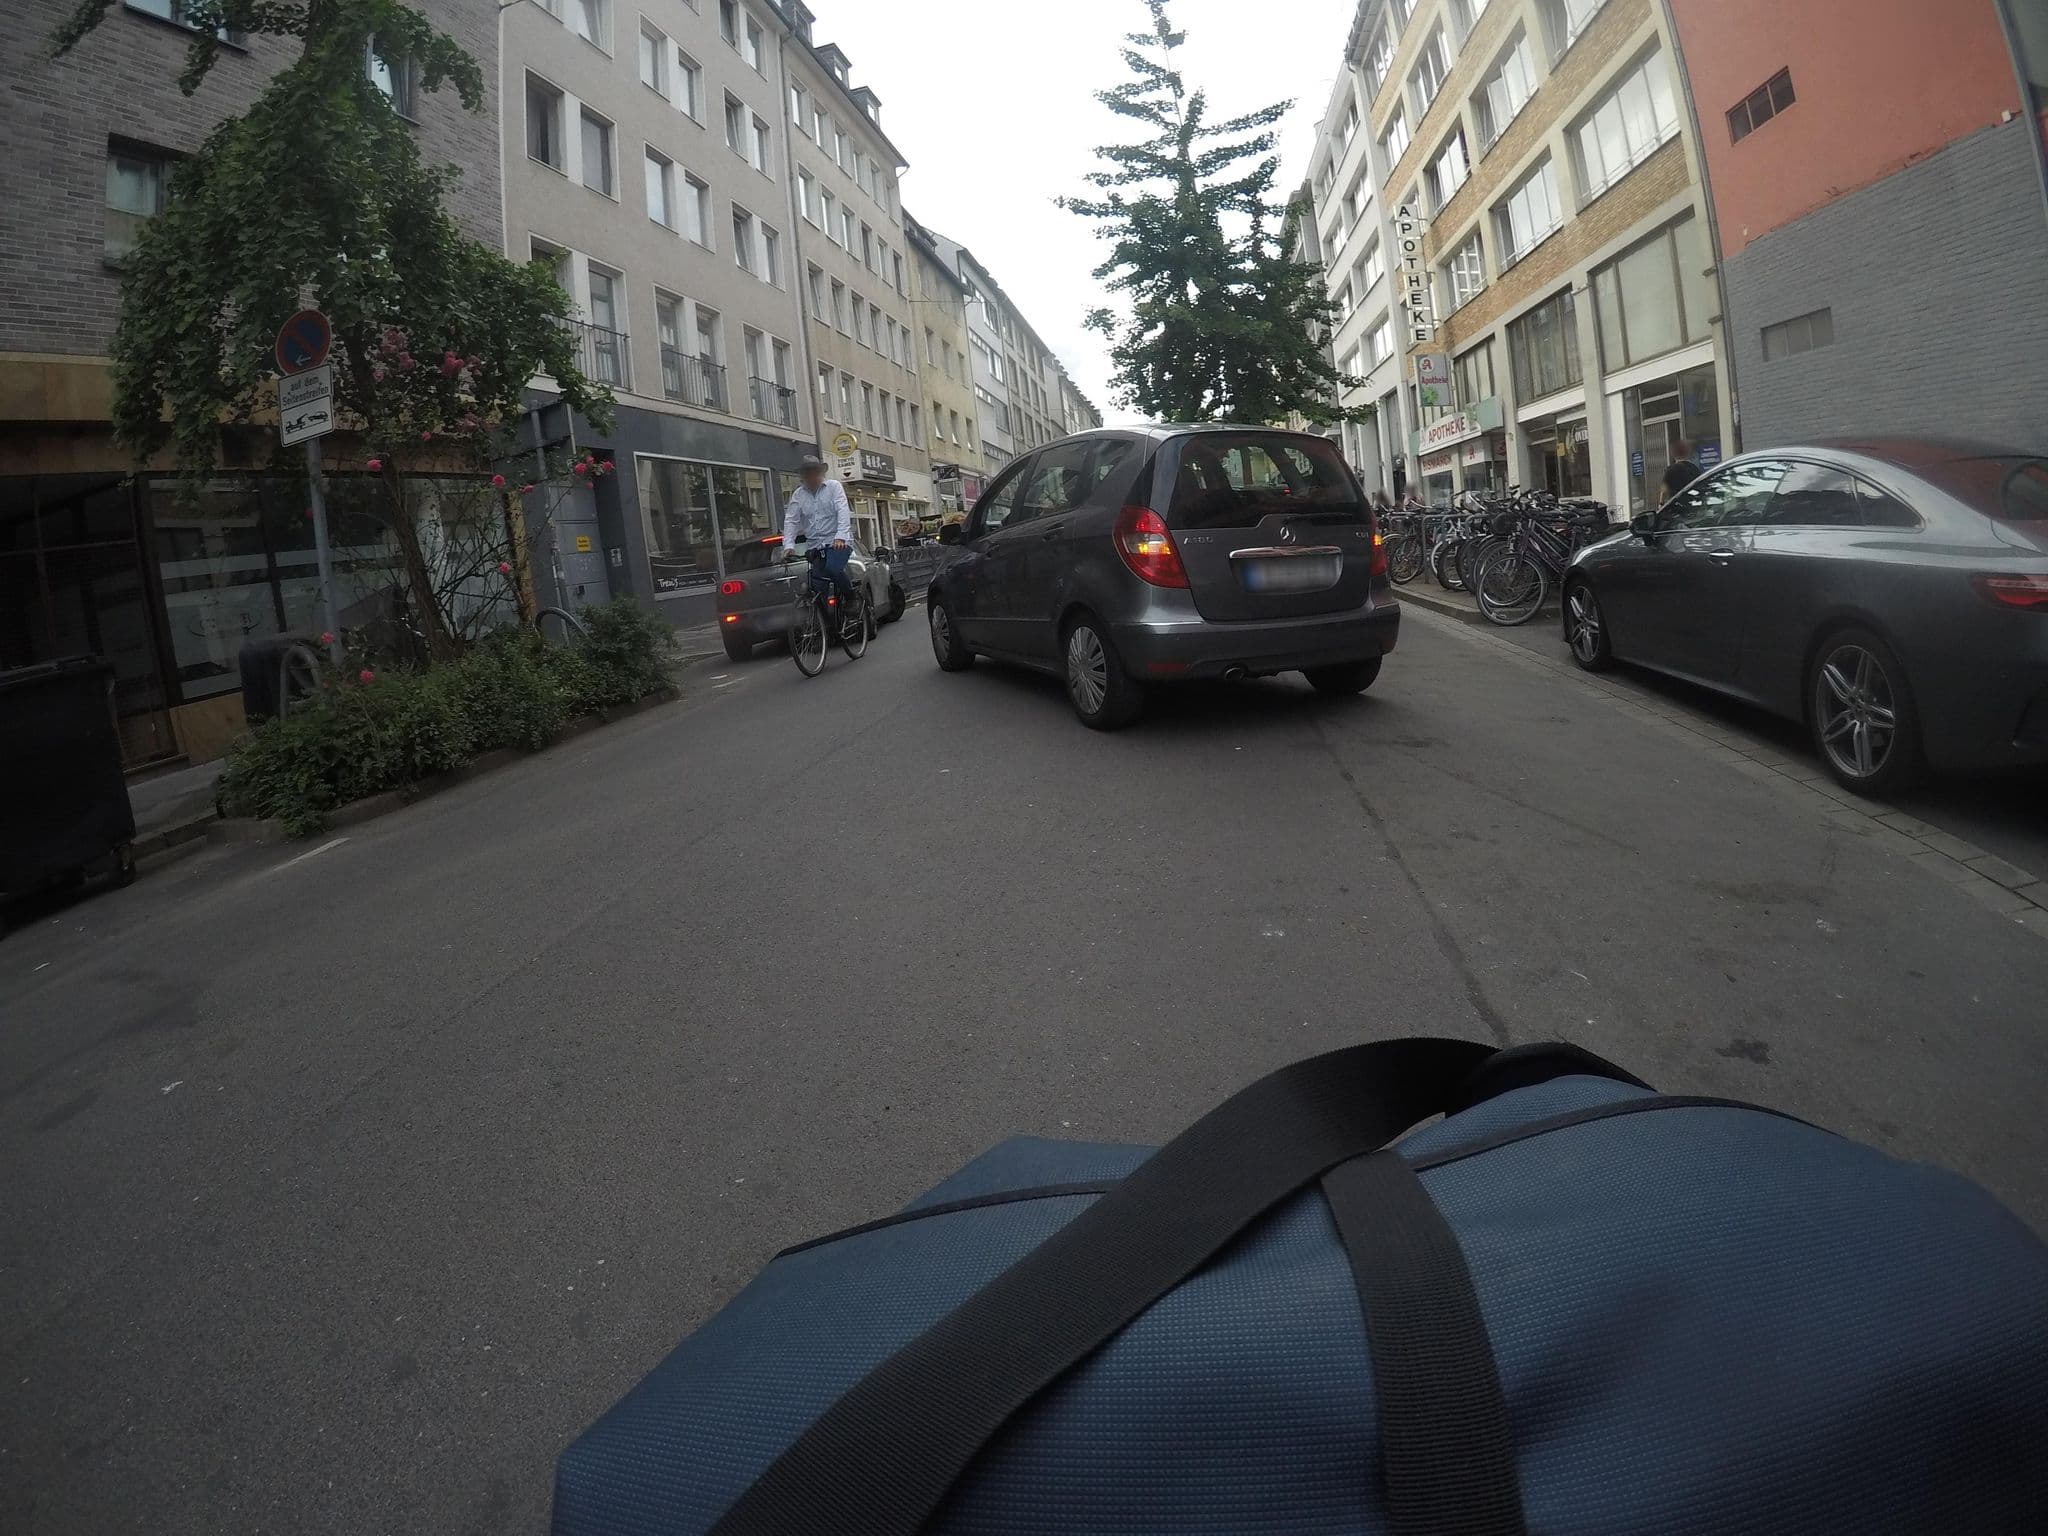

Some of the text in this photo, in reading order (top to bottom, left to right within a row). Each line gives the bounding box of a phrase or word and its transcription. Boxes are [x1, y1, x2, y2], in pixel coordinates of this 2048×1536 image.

[1399, 205, 1427, 341] APOTHEKE
[1421, 376, 1449, 385] Apotheke
[1428, 416, 1466, 443] APOTHEKE
